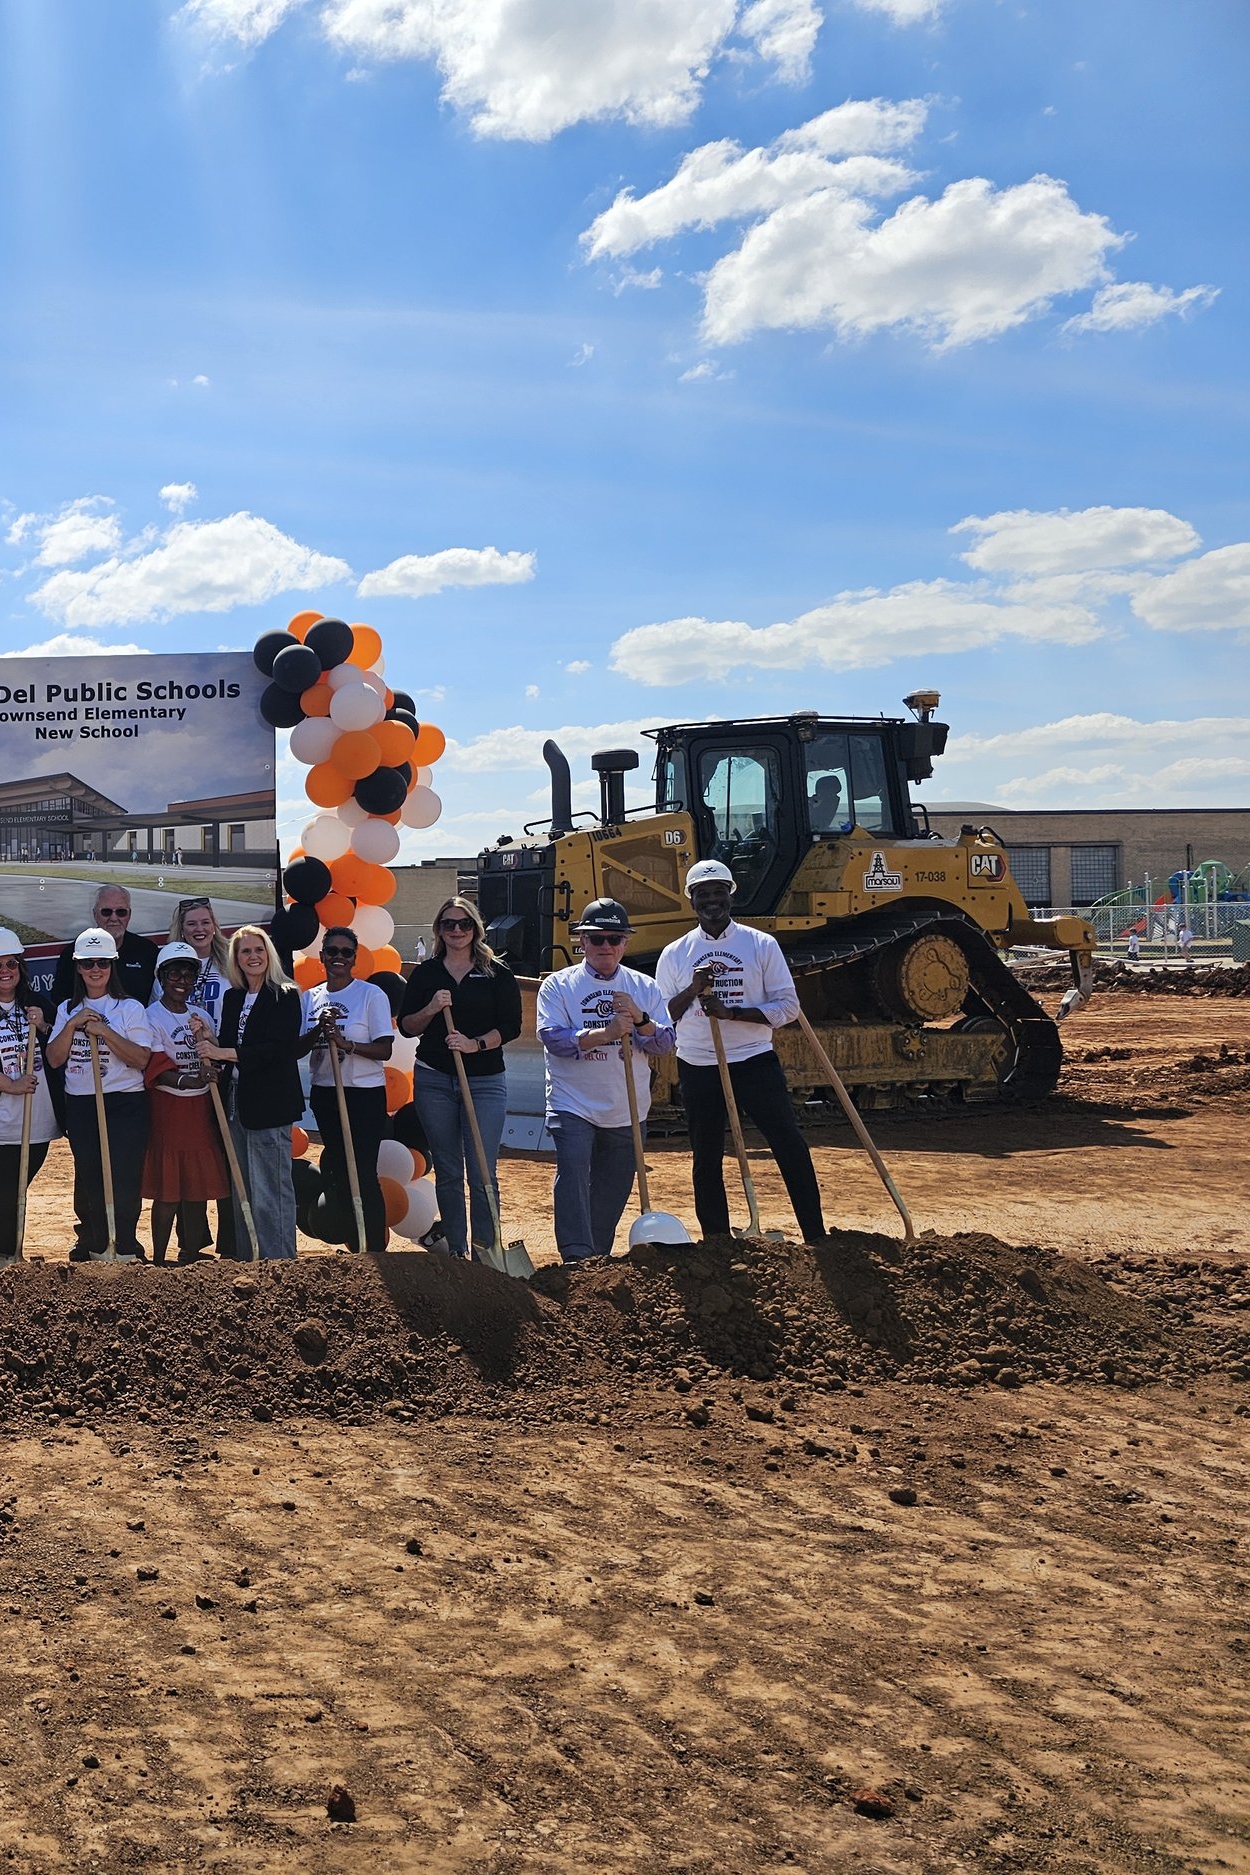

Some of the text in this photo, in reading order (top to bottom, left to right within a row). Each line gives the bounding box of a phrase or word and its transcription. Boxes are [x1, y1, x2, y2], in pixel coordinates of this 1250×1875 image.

[46, 682, 127, 703] Public
[136, 680, 241, 701] Schools
[84, 705, 187, 721] Elementary
[35, 724, 139, 740] New School
[14, 815, 46, 824] ELEMENTARY
[47, 814, 69, 822] SCHOOL
[665, 830, 681, 845] D6
[502, 853, 515, 867] CAT
[971, 855, 998, 877] CAT
[915, 871, 946, 882] 17-038
